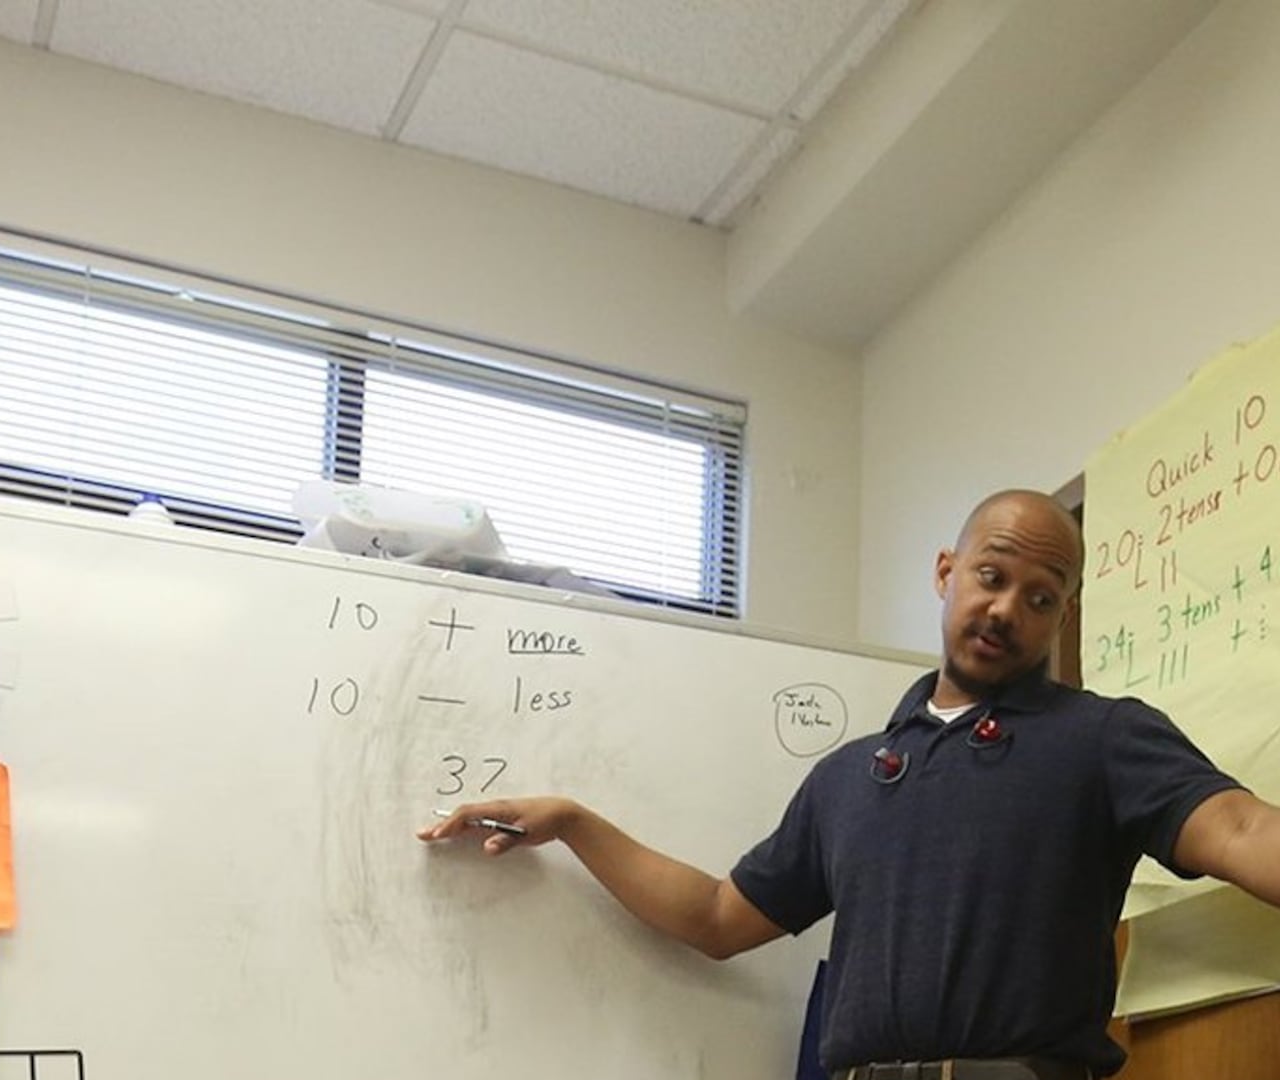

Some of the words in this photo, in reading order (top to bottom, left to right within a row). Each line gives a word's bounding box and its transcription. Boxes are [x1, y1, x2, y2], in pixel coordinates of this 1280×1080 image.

[1146, 431, 1215, 498] Quick
[1234, 395, 1266, 444] 10
[1157, 603, 1173, 644] 3
[1180, 593, 1222, 630] tens
[1259, 544, 1273, 582] 4
[327, 596, 379, 631] 10
[505, 628, 582, 654] more
[306, 676, 359, 716] 10
[513, 676, 573, 713] less
[435, 756, 508, 796] 37
